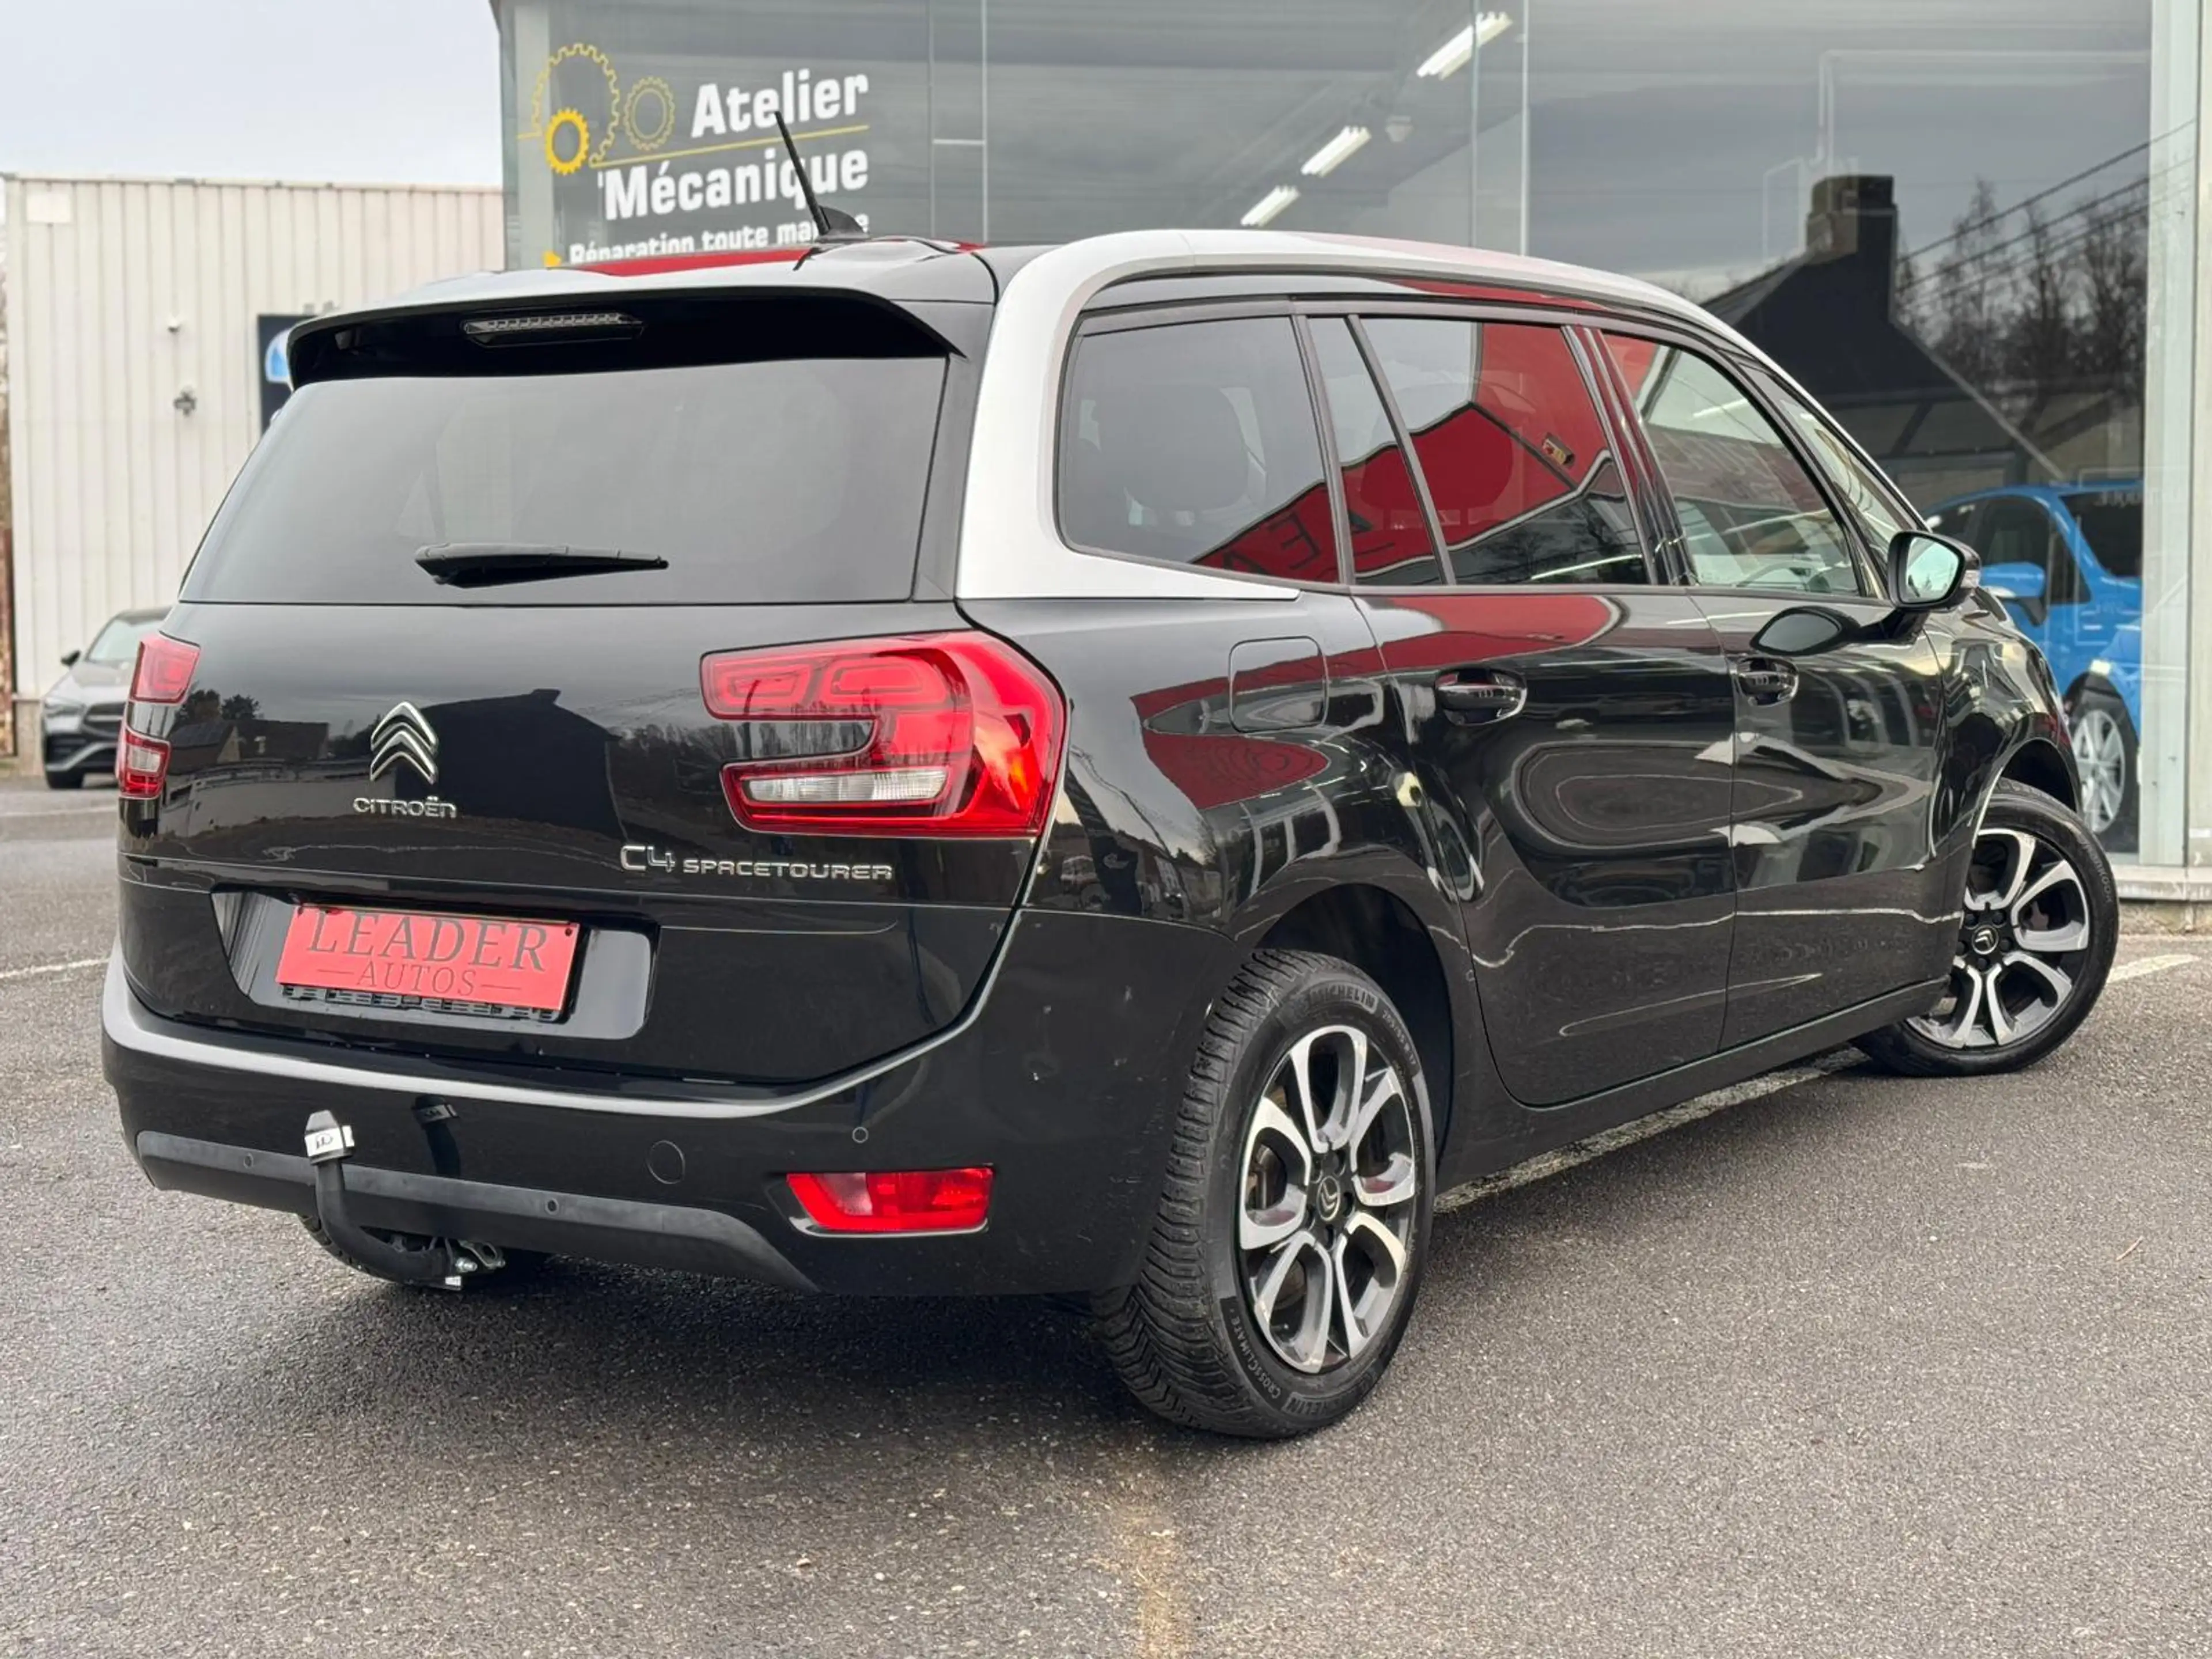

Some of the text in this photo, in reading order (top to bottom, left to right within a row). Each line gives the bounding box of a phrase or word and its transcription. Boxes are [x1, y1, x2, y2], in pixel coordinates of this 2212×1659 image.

[692, 69, 869, 138] Atelier
[702, 224, 766, 251] toute
[620, 845, 893, 880] C4 SPACETOURER
[306, 911, 550, 972] LEADER
[356, 960, 477, 996] AUTOS
